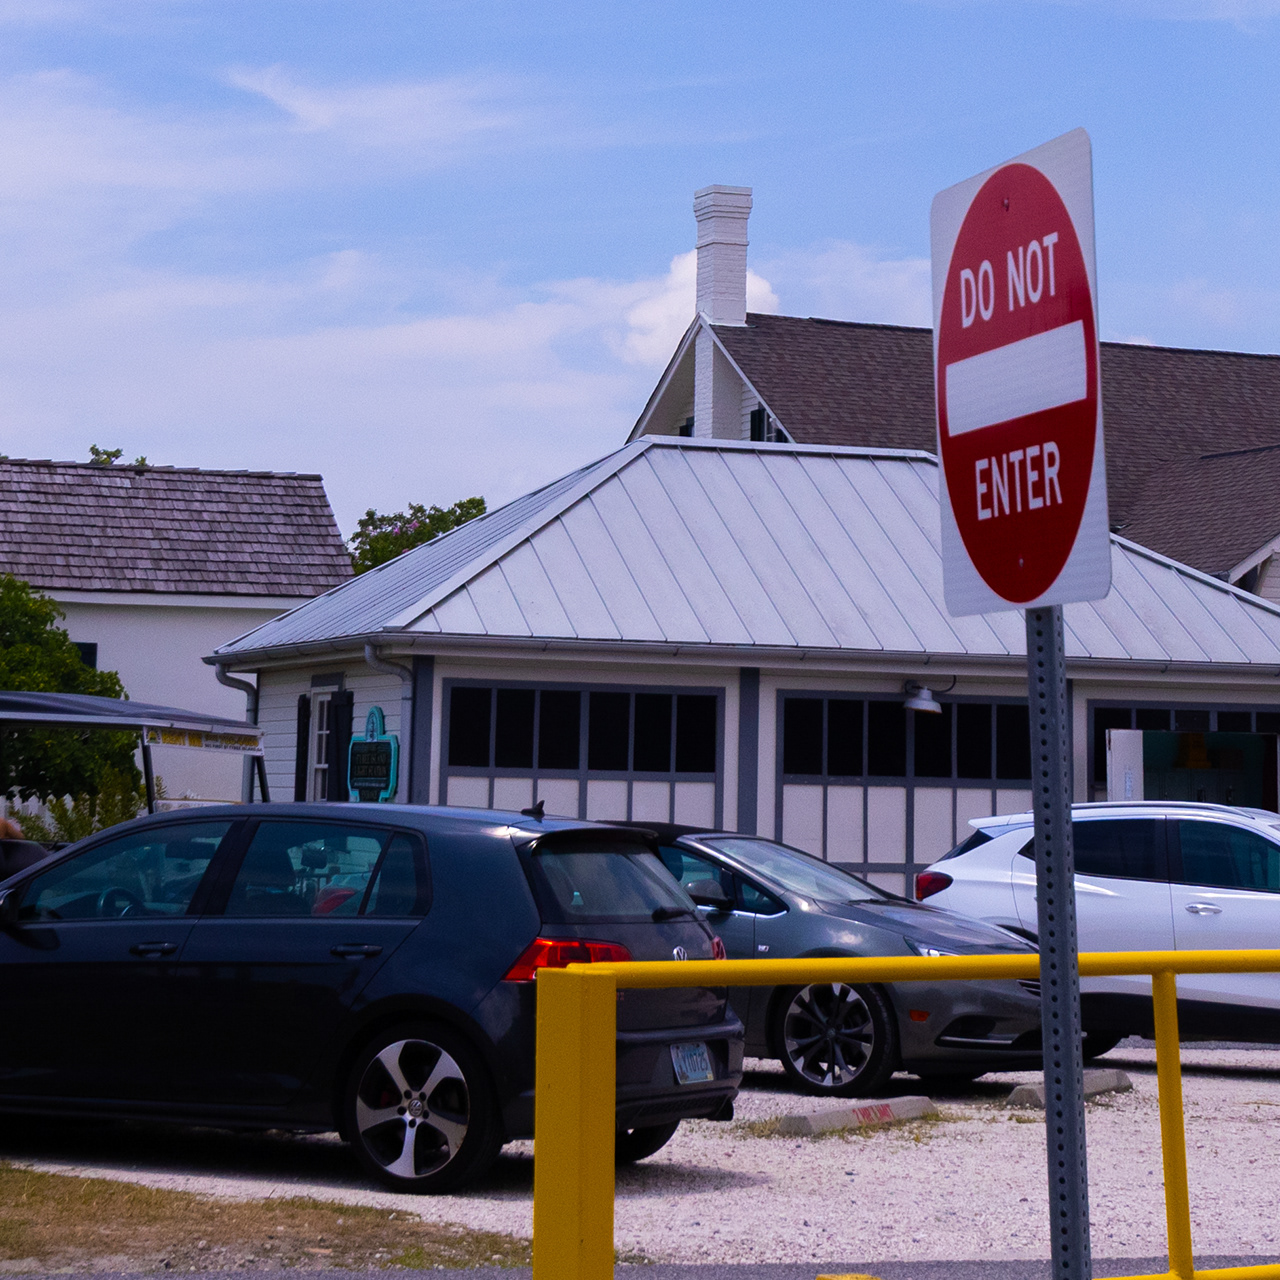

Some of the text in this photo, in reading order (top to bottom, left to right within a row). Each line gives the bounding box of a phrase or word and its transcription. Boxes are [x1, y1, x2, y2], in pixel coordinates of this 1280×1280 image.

[960, 231, 1059, 329] DO NOT
[975, 440, 1063, 521] ENTER
